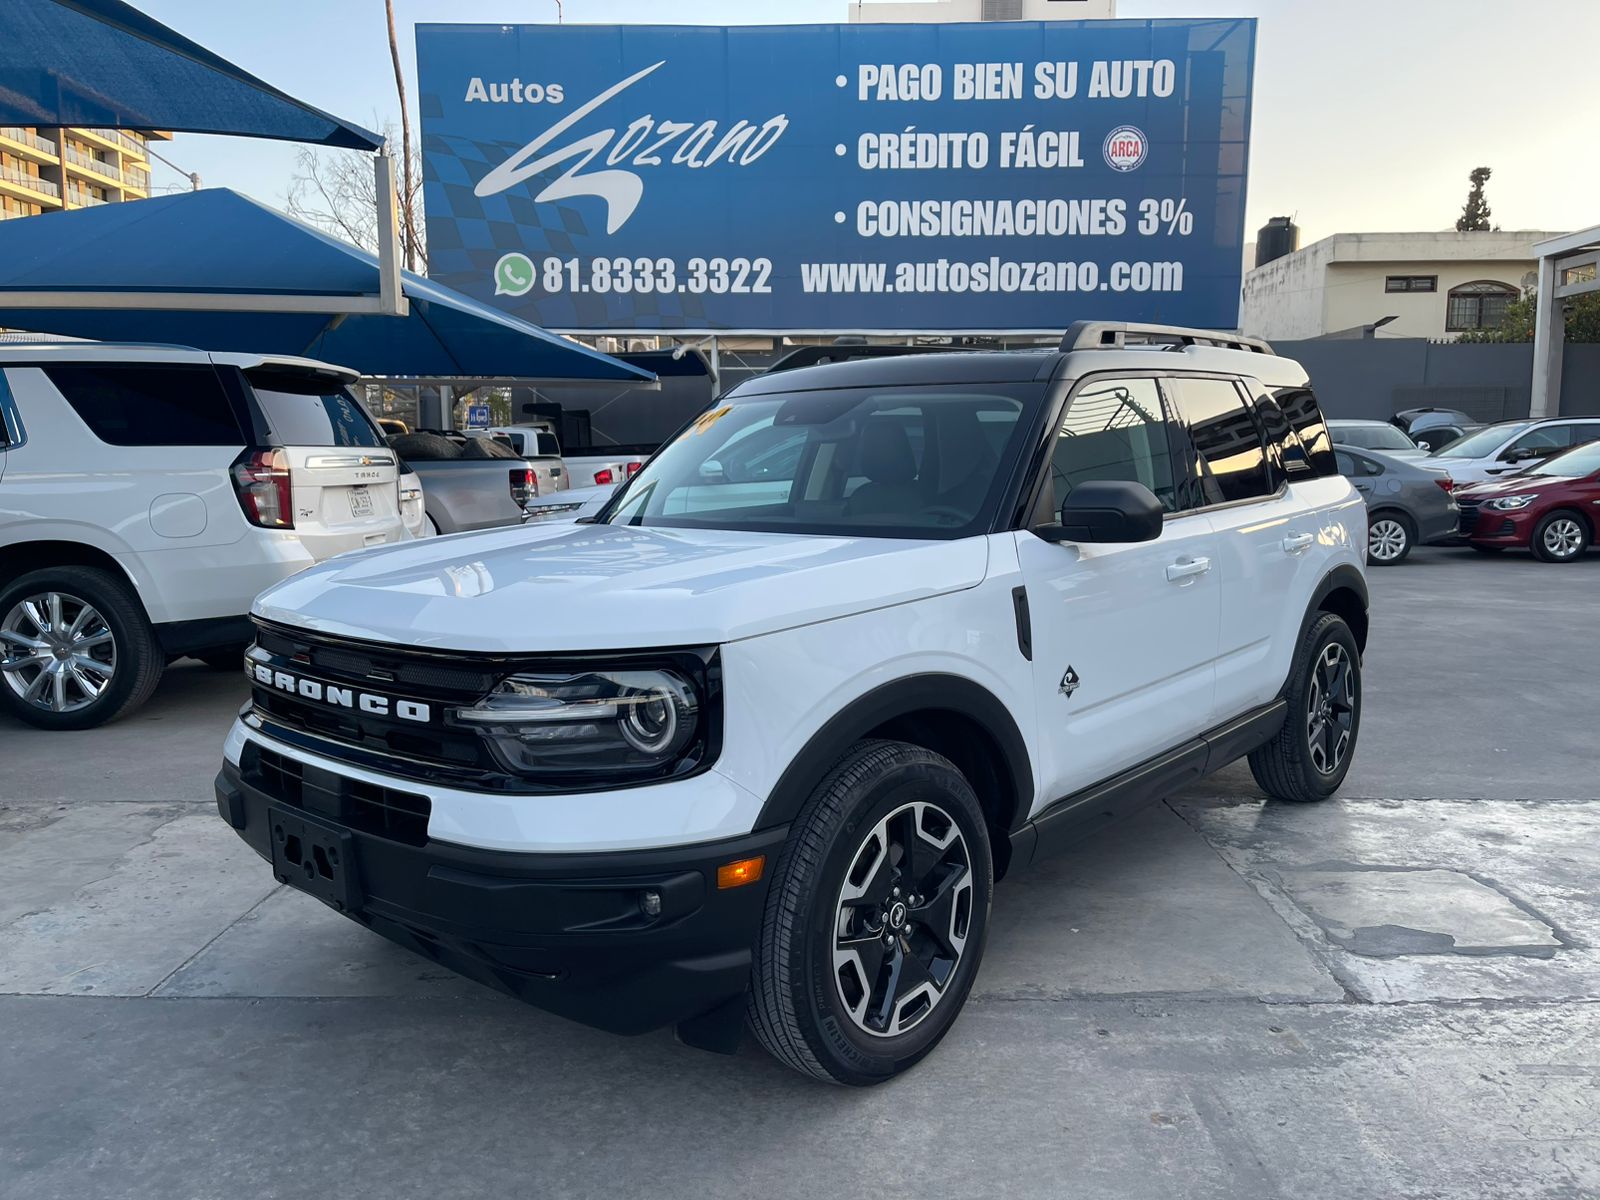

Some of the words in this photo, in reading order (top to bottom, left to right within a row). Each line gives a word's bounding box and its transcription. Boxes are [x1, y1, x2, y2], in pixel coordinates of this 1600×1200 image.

[465, 78, 564, 104] Autos
[859, 63, 942, 101] PAGO
[954, 62, 1023, 100] BIEN
[1034, 61, 1078, 99] SU
[1088, 59, 1176, 98] AUTO
[474, 60, 789, 235] Lozano
[858, 125, 988, 170] CRÉDITO
[1000, 124, 1084, 168] FÁCIL
[1111, 140, 1139, 157] ARCA
[857, 199, 1126, 237] CONSIGNACIONES
[1138, 198, 1193, 236] 3%
[542, 257, 772, 294] 81.8333.3322
[800, 256, 1183, 293] www.autoslozano.com
[255, 664, 430, 723] BRONCO
